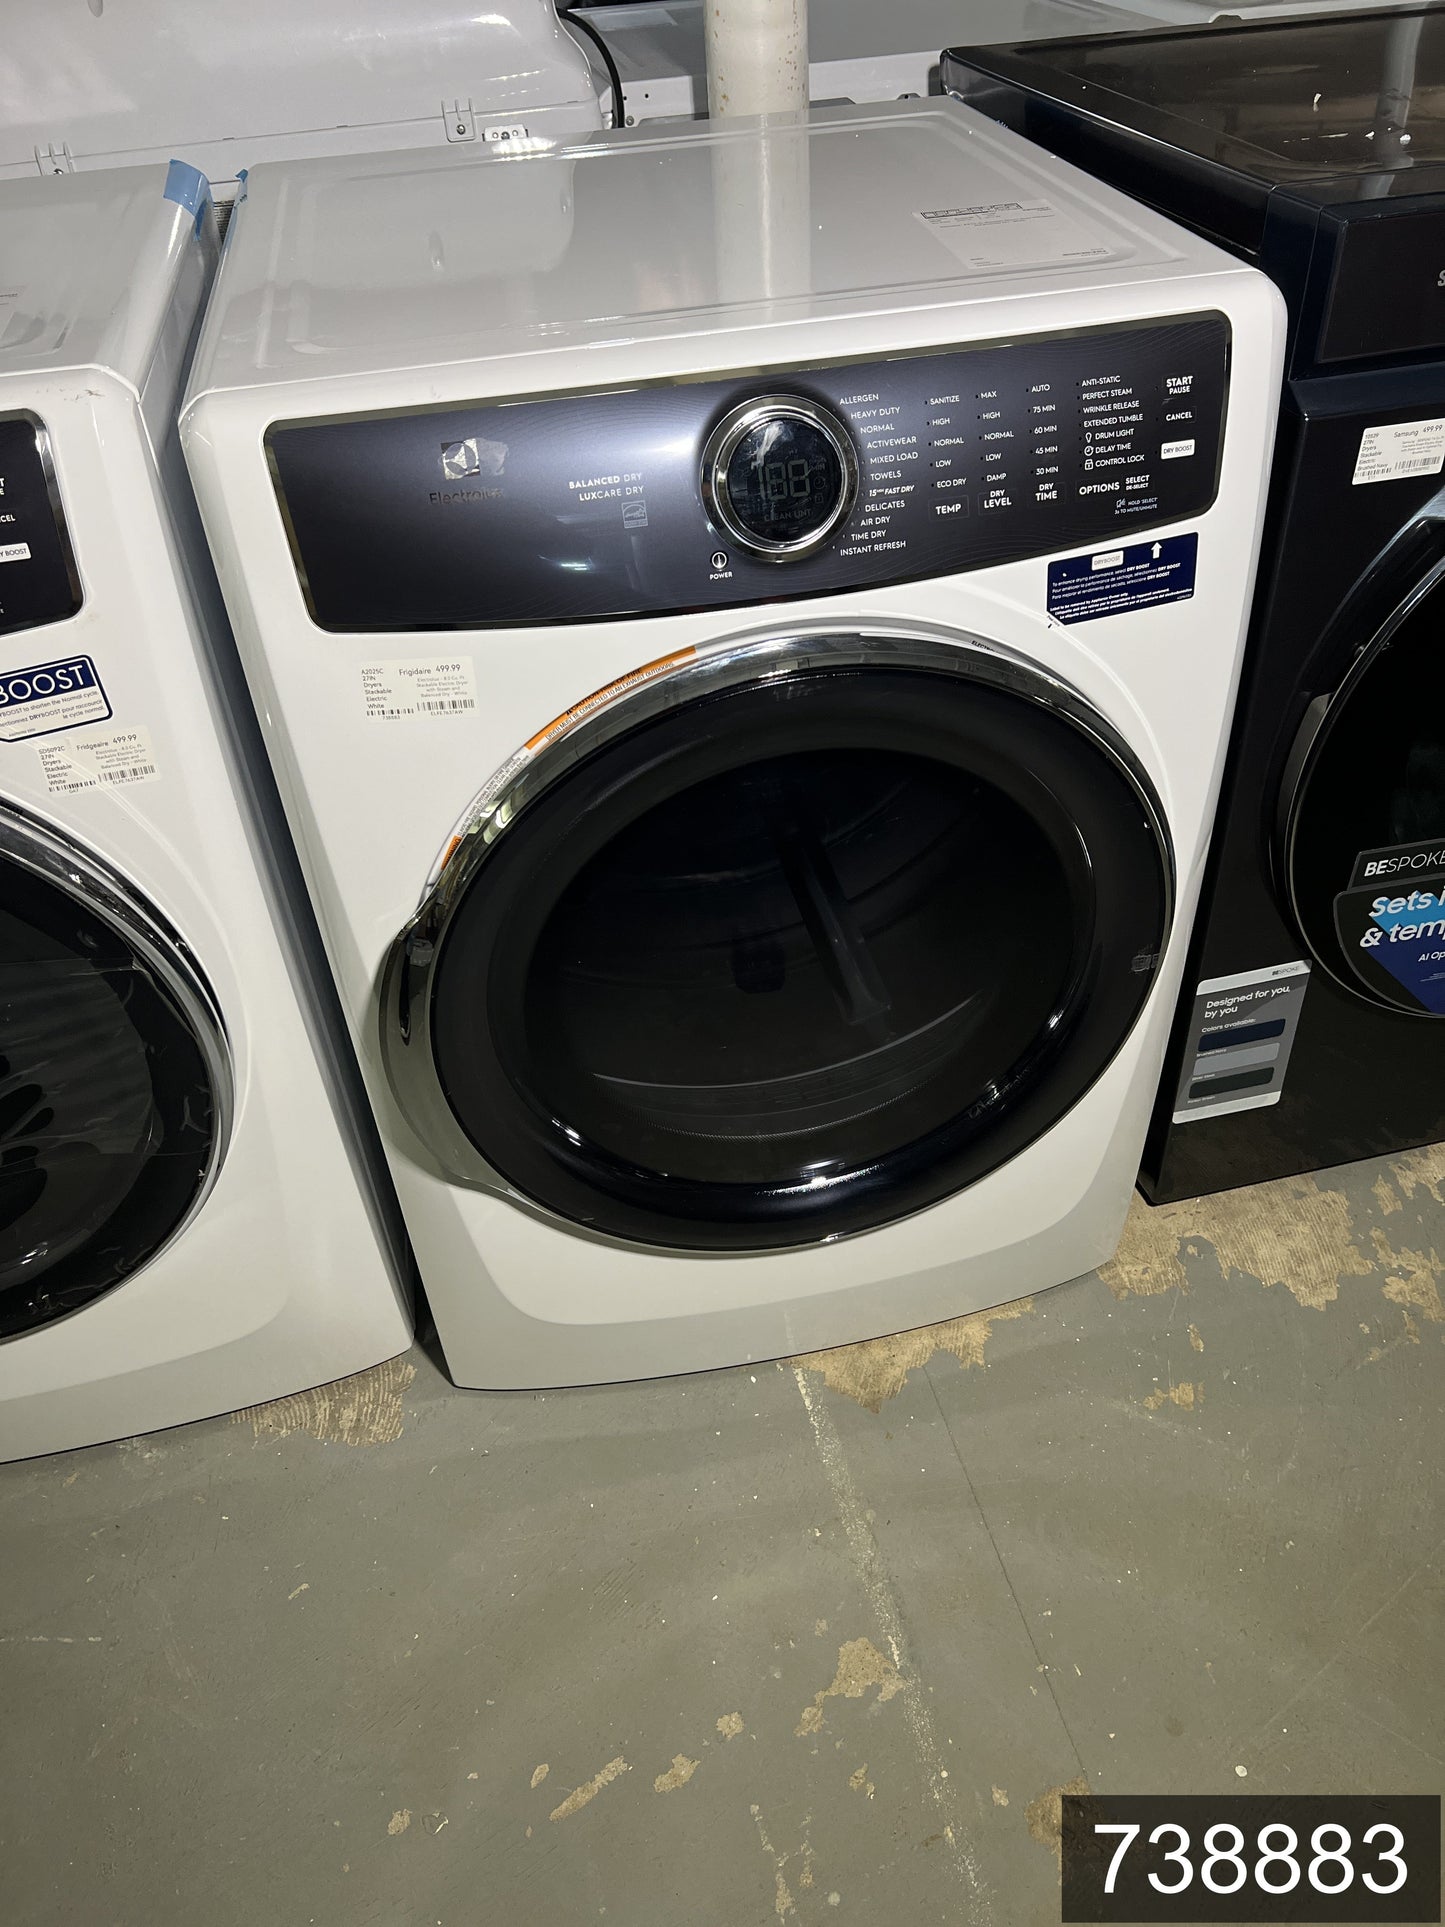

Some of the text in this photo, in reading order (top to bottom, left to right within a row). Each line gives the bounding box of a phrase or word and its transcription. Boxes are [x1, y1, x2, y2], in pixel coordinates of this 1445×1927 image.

[1082, 376, 1120, 387] ANTI-STATIC
[1166, 376, 1193, 388] START
[1032, 384, 1050, 392] AUTO
[1169, 386, 1190, 394] PAUSE
[840, 394, 879, 405] ALLERGEN
[1082, 388, 1132, 400] PERFECT STEAM
[930, 395, 960, 405] SANITIZE
[1083, 400, 1140, 414] WRINKLE RELEASE
[851, 406, 900, 420] HEAVY DUTY
[1166, 411, 1192, 422] CANCEL
[932, 418, 950, 426] HIGH
[1084, 414, 1143, 428] EXTENDED TUMBLE
[860, 424, 895, 434] NORMAL
[1095, 428, 1134, 440] DRUM LIGHT
[984, 430, 1014, 440] NORMAL
[867, 436, 916, 448] ACTIVEWEAR
[934, 437, 964, 446] NORMAL
[1096, 442, 1131, 454] DELAY TIME
[1175, 444, 1192, 452] BOOST
[870, 452, 918, 464] MIXED LOAD
[986, 453, 1002, 461] LOW
[1095, 454, 1145, 468] CONTROL LOCK
[936, 460, 952, 468] LOW
[870, 470, 902, 481] TOWELS
[1045, 466, 1058, 474] MIN
[568, 472, 642, 490] BALANCED DRY
[936, 478, 966, 488] ECO DRY
[986, 473, 1006, 482] DAMP
[1126, 475, 1150, 484] SELECT
[884, 487, 900, 495] FAST
[901, 485, 914, 494] DRY
[1039, 483, 1054, 491] DRY
[1079, 482, 1120, 496] OPTIONS
[579, 485, 645, 502] LUXCARE DRY
[990, 489, 1005, 498] DRY
[1036, 490, 1058, 502] TIME
[865, 500, 906, 512] DELICATES
[984, 497, 1012, 508] LEVEL
[936, 503, 962, 515] TEMP
[0, 514, 16, 523] CEL
[876, 516, 890, 524] DRY
[851, 530, 886, 541] TIME DRY
[840, 540, 906, 556] INSTANT REFRESH
[710, 571, 732, 580] POWER
[399, 668, 432, 677] Frigidaire
[436, 664, 460, 672] 499.99
[0, 664, 84, 705] BOOST
[112, 734, 137, 744] 499.99
[1364, 850, 1445, 877] BESPOKE
[1368, 890, 1434, 918] Sets
[1360, 919, 1445, 948] & tem
[1206, 994, 1253, 1009] Designed
[1255, 990, 1270, 999] for
[1204, 1006, 1238, 1019] by you
[1201, 1024, 1223, 1033] Colors
